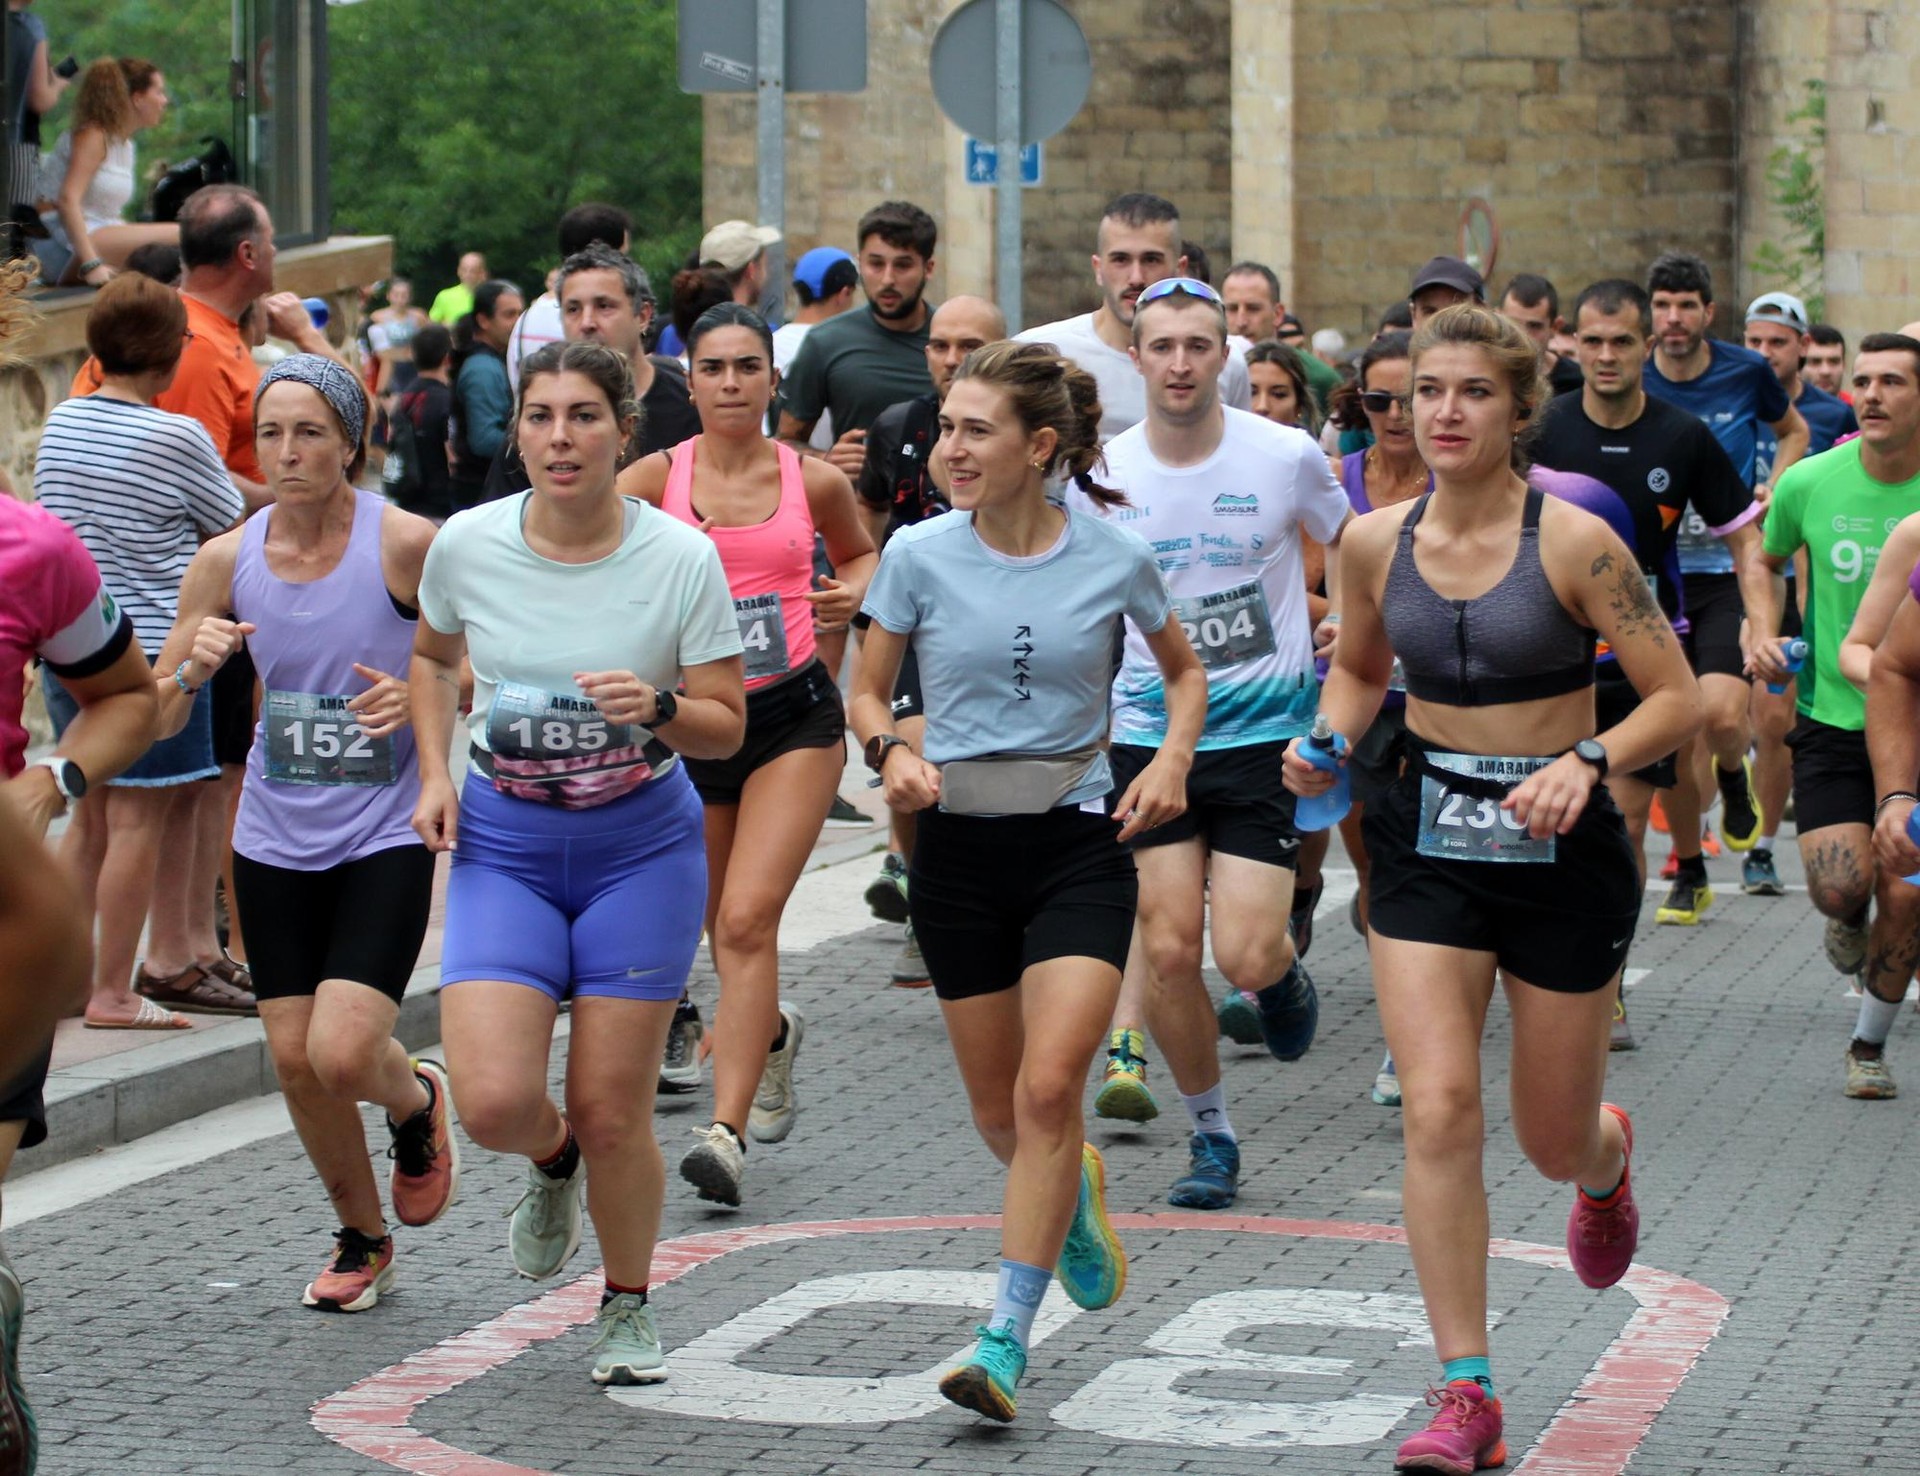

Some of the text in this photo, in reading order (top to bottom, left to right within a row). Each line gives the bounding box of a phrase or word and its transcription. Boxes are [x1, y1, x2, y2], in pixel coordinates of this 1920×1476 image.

[1831, 539, 1863, 583] 9
[1180, 608, 1256, 650] 204
[284, 720, 374, 758] 152
[509, 717, 608, 750] 185
